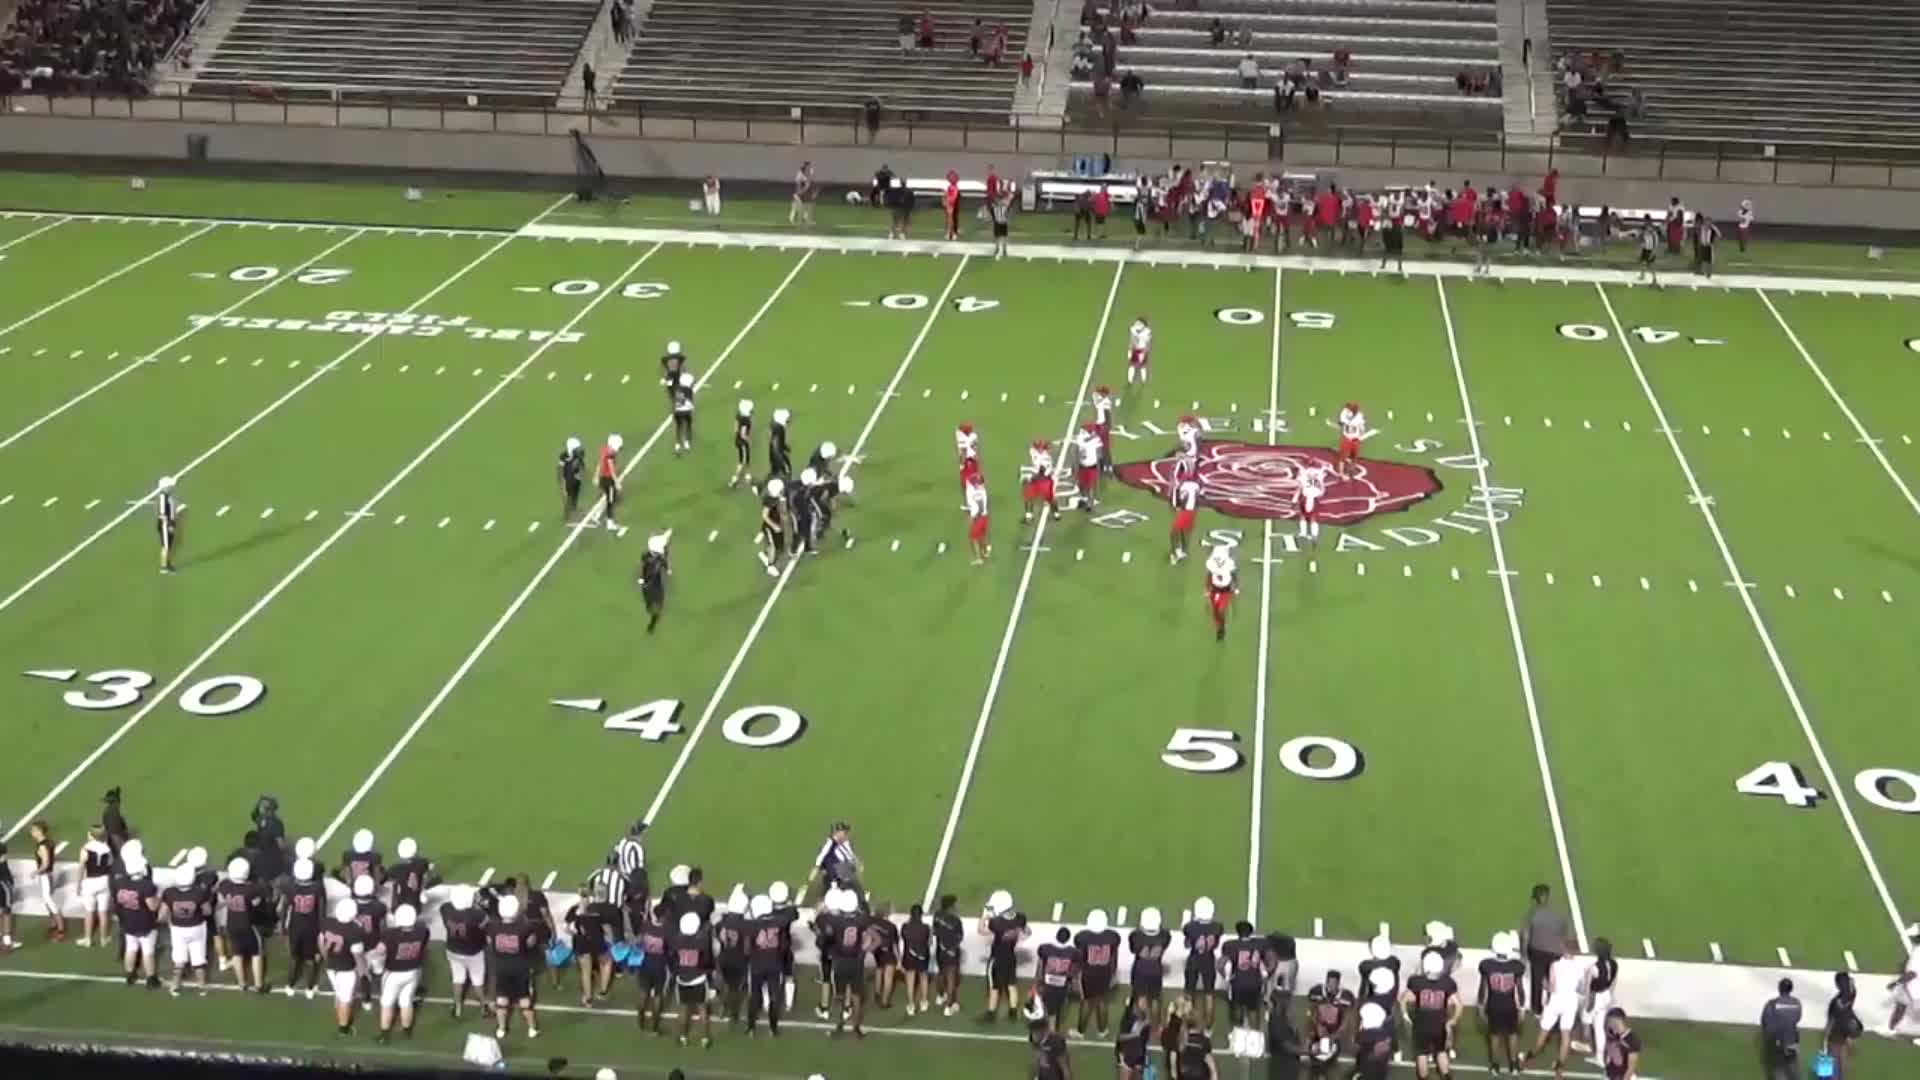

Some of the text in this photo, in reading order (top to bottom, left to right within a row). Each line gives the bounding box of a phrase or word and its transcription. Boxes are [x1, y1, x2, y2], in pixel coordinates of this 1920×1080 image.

[228, 265, 353, 285] 20
[550, 279, 672, 299] 30
[880, 293, 1001, 313] 40
[1215, 307, 1337, 329] 50
[1557, 323, 1681, 344] 40
[63, 668, 266, 716] 30
[603, 698, 806, 748] 40
[1160, 727, 1364, 780] 50
[1735, 761, 1920, 813] 40
